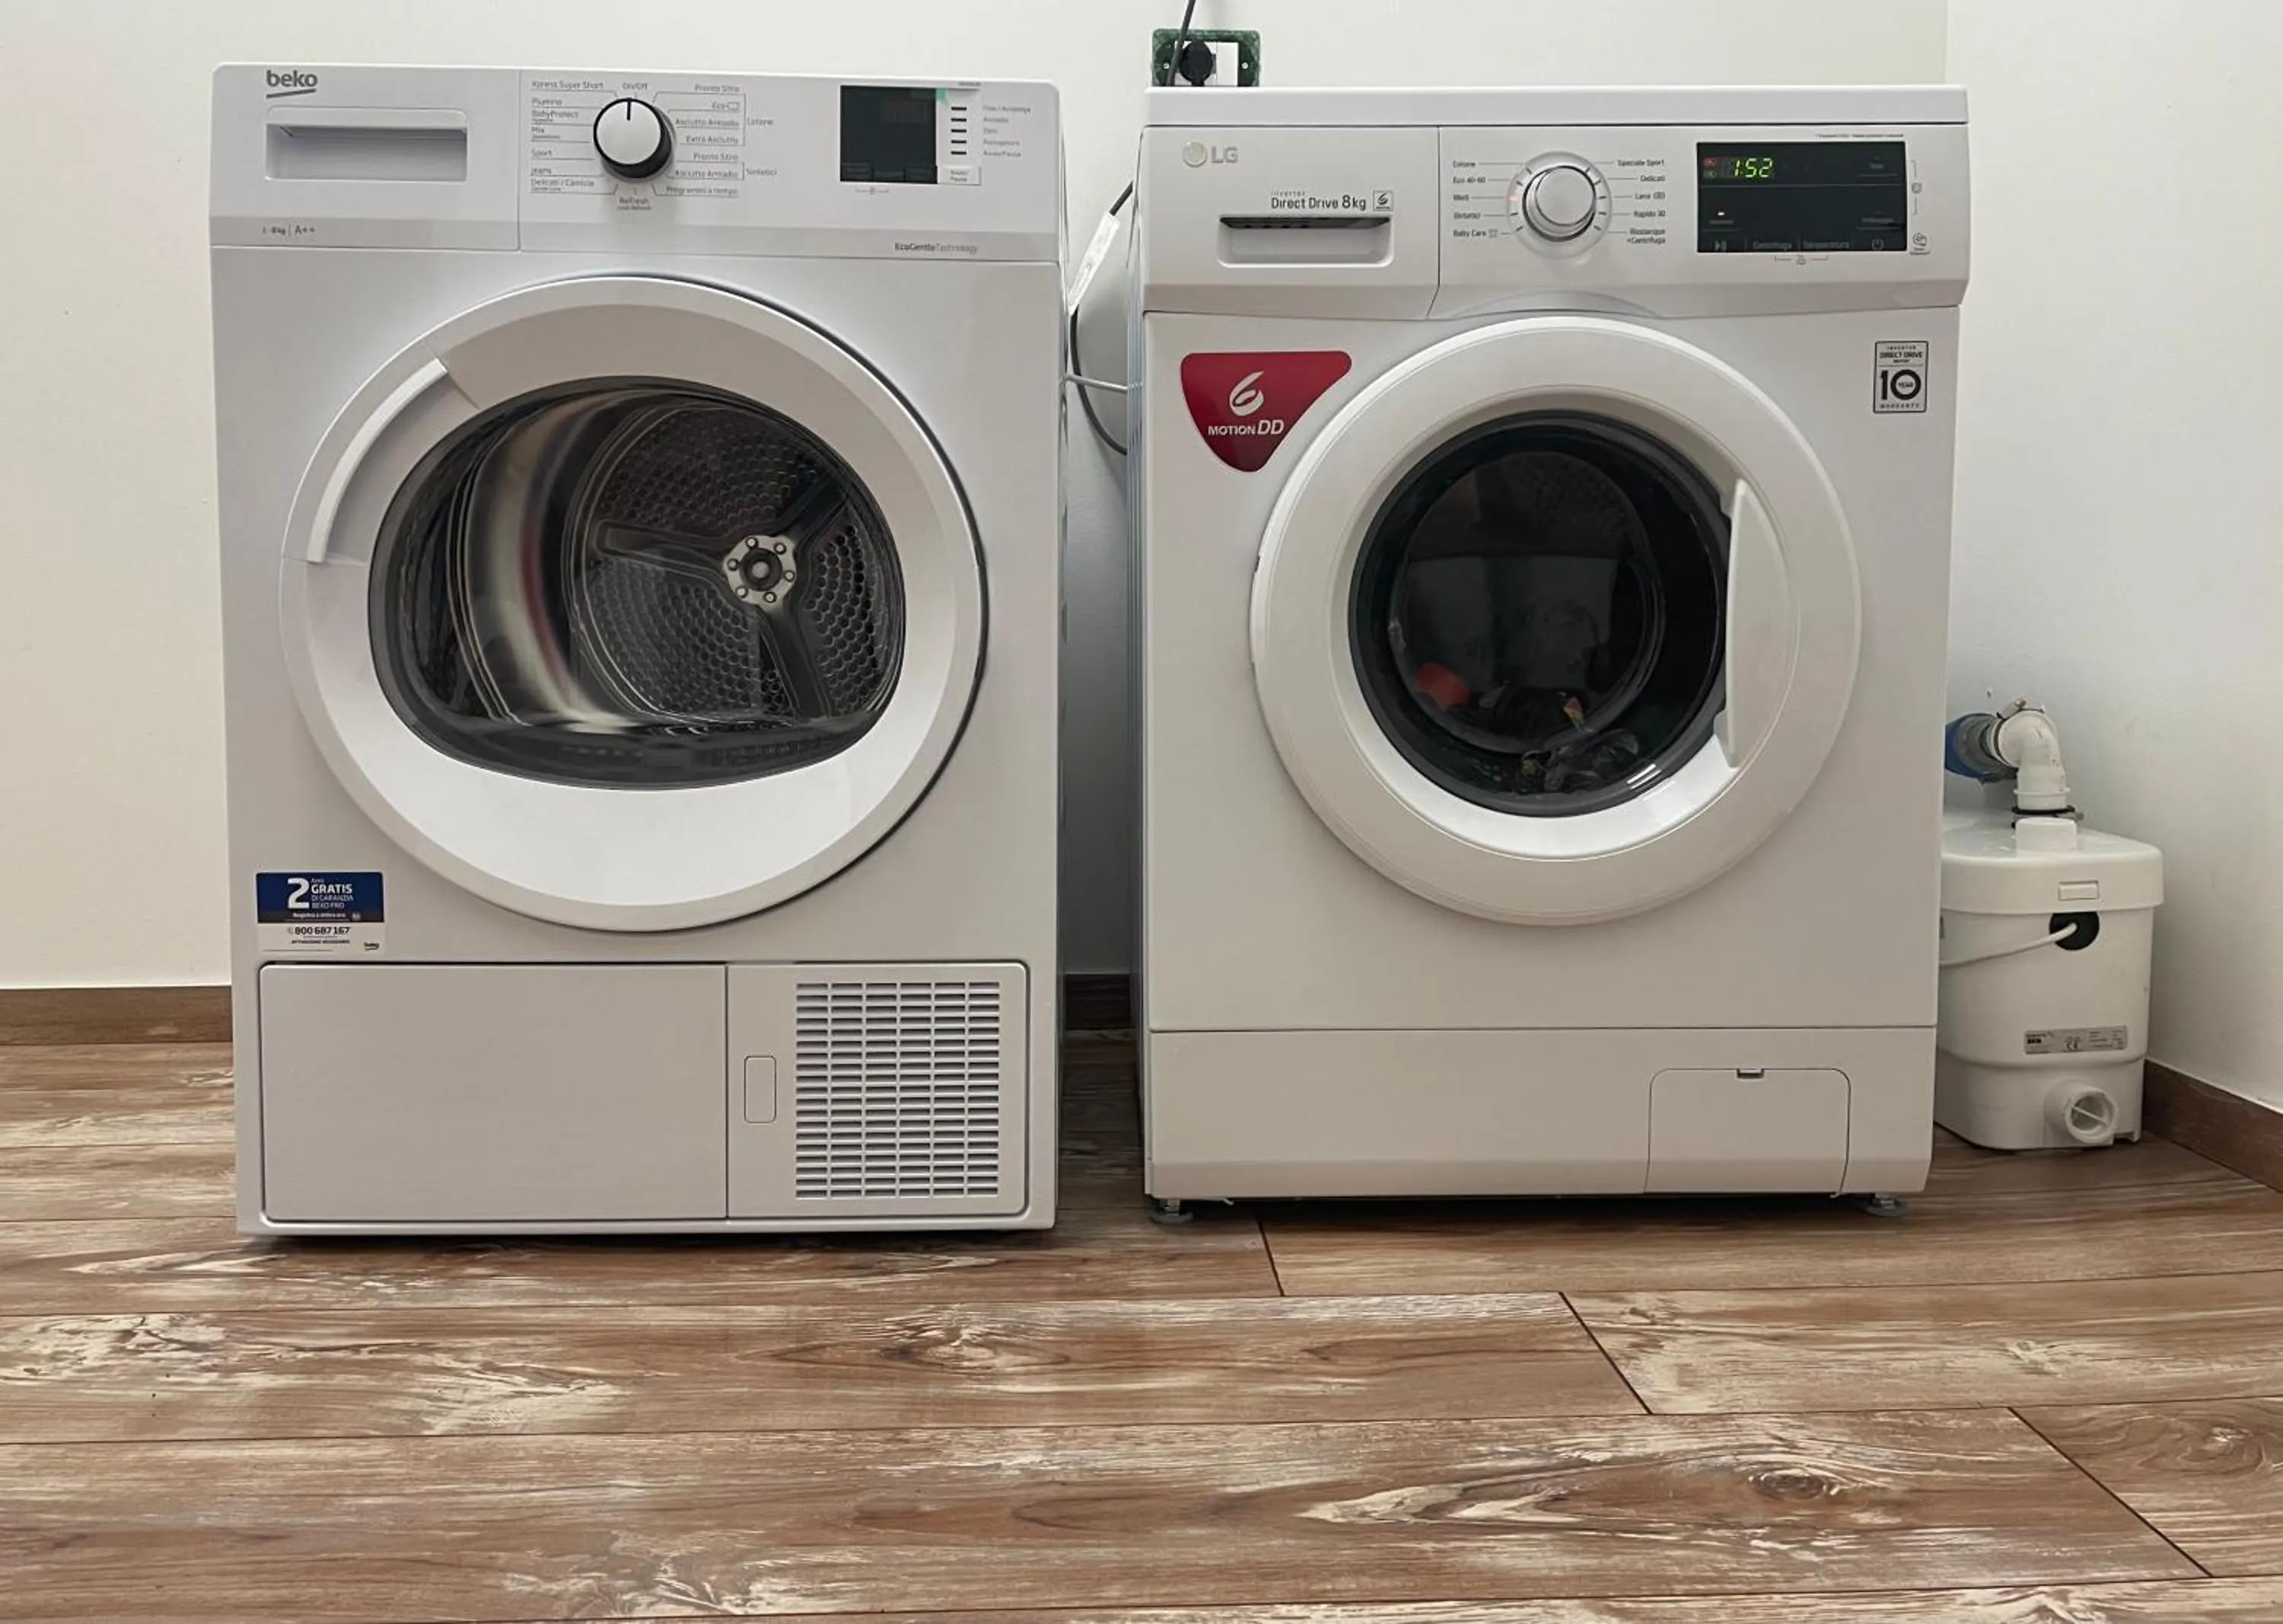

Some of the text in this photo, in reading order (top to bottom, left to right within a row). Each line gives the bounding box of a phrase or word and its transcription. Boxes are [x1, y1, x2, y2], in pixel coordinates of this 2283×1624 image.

[266, 69, 318, 88] beko
[1211, 145, 1239, 164] LG
[1734, 157, 1774, 179] 1:52
[1270, 196, 1307, 210] Direct
[1308, 197, 1339, 210] Drive
[1880, 369, 1922, 401] 10
[1208, 419, 1285, 436] MOTION DD
[287, 877, 310, 910] 2
[310, 884, 353, 895] GRATIS
[295, 926, 351, 935] 800 687 167
